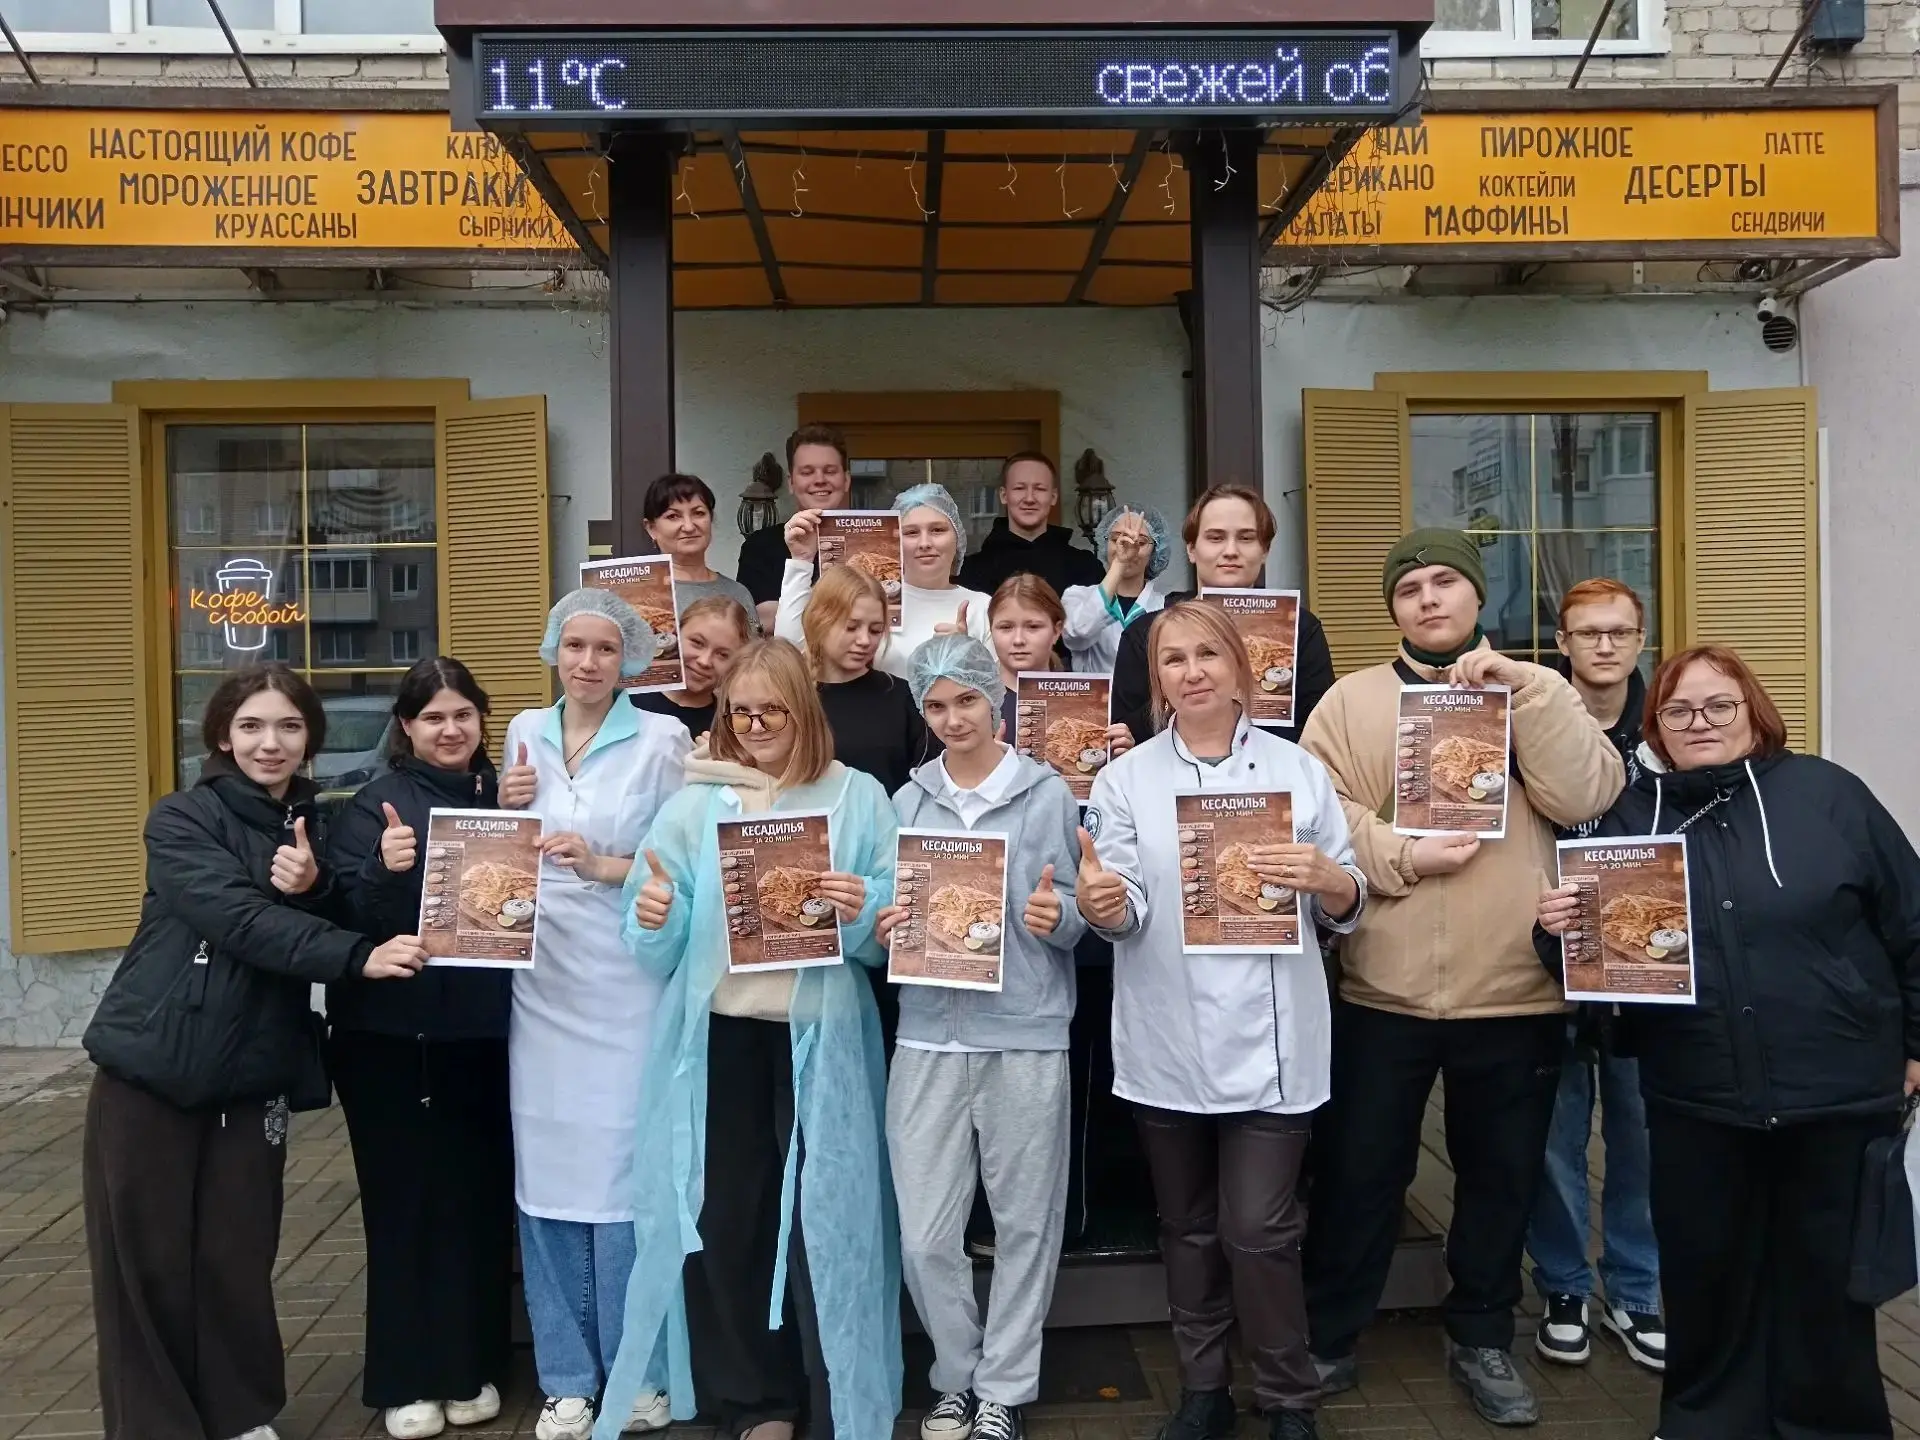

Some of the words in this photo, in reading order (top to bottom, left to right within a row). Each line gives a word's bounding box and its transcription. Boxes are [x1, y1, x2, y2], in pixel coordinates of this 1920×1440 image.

[1096, 47, 1303, 103] свежей
[90, 124, 270, 166] НАСТОЯЩИЙ
[281, 131, 357, 162] КОФЕ
[1480, 126, 1634, 158] ПИРОЖНОЕ
[1764, 131, 1826, 155] ЛАТТЕ
[119, 172, 319, 206] МОРОЖЕННОЕ
[356, 169, 526, 208] ЗАВТРАКИ
[1319, 163, 1435, 193] ЕРИКАНО
[1479, 170, 1576, 198] КОКТЕЙЛИ
[1624, 162, 1766, 205] ДЕСЕРТЫ
[0, 195, 105, 230] НЧИКИ
[1290, 210, 1381, 237] САЛАТЫ
[1424, 204, 1569, 236] МАФФИНЫ
[1731, 211, 1826, 235] СЕНДВИЧИ
[215, 211, 358, 240] КРУАССАНЫ
[459, 215, 554, 239] СЫРНИКИ
[835, 518, 882, 527] КЕСАДИЛЬЯ
[599, 565, 651, 579] КЕСАДИЛЬЯ
[189, 588, 265, 614] Кофе
[1223, 598, 1277, 608] КЕСАДИЛЬЯ
[209, 611, 228, 624] с
[230, 603, 308, 625] собой
[1038, 682, 1090, 691] КЕСАДИЛЬЯ
[1423, 695, 1484, 706] КЕСАДИЛЬЯ
[1201, 797, 1267, 810] КЕСАДИЛЬЯ
[455, 819, 519, 832] КЕСАДИЛЬЯ
[741, 821, 805, 837] КЕСАДИЛЬЯ
[921, 839, 982, 853] КЕСАДИЛЬЯ
[1584, 848, 1656, 862] КЕСАДИЛЬЯ
